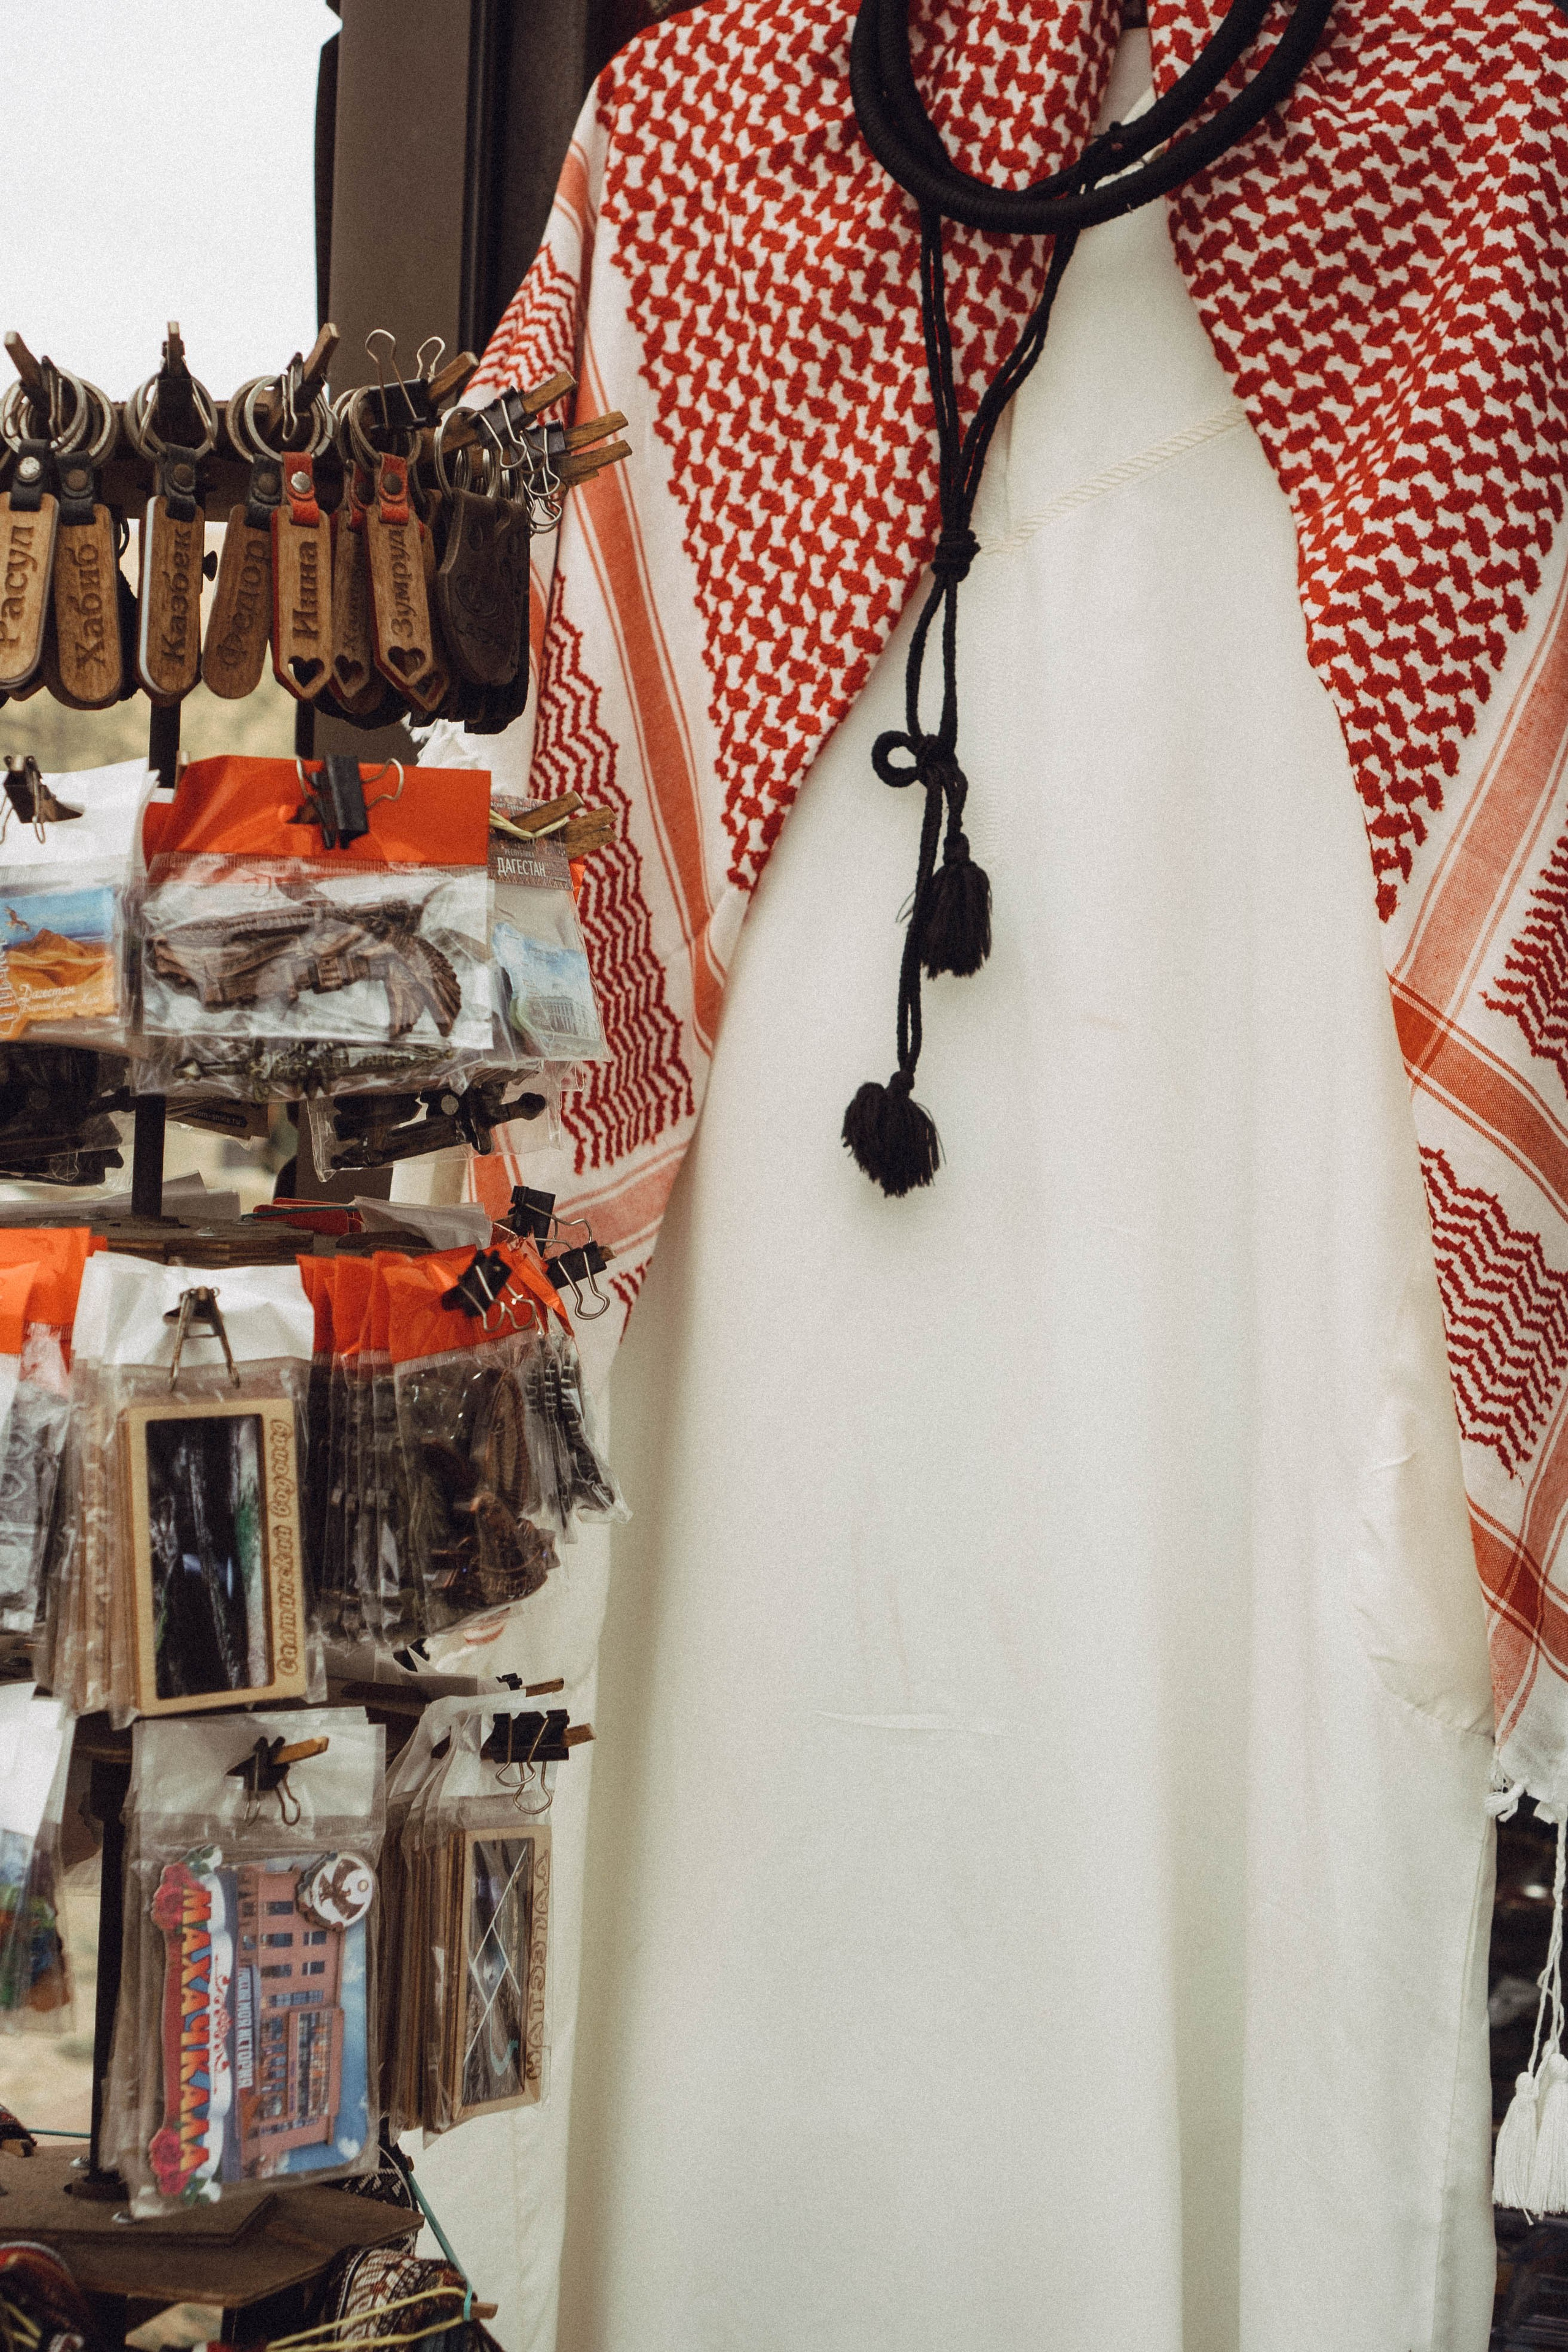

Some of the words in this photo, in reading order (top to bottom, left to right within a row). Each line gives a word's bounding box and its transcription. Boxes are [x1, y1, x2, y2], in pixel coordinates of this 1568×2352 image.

[0, 525, 37, 648] Расул
[64, 544, 105, 669] Хабиб
[162, 529, 192, 665] Казбек
[216, 540, 270, 671] Федор
[292, 541, 318, 639] Инна
[497, 856, 546, 878] ДАГЕСТАН
[270, 1419, 295, 1519] водопад
[273, 1525, 298, 1678] Салтинский
[179, 1888, 212, 2173] МАХАЧКАЛА
